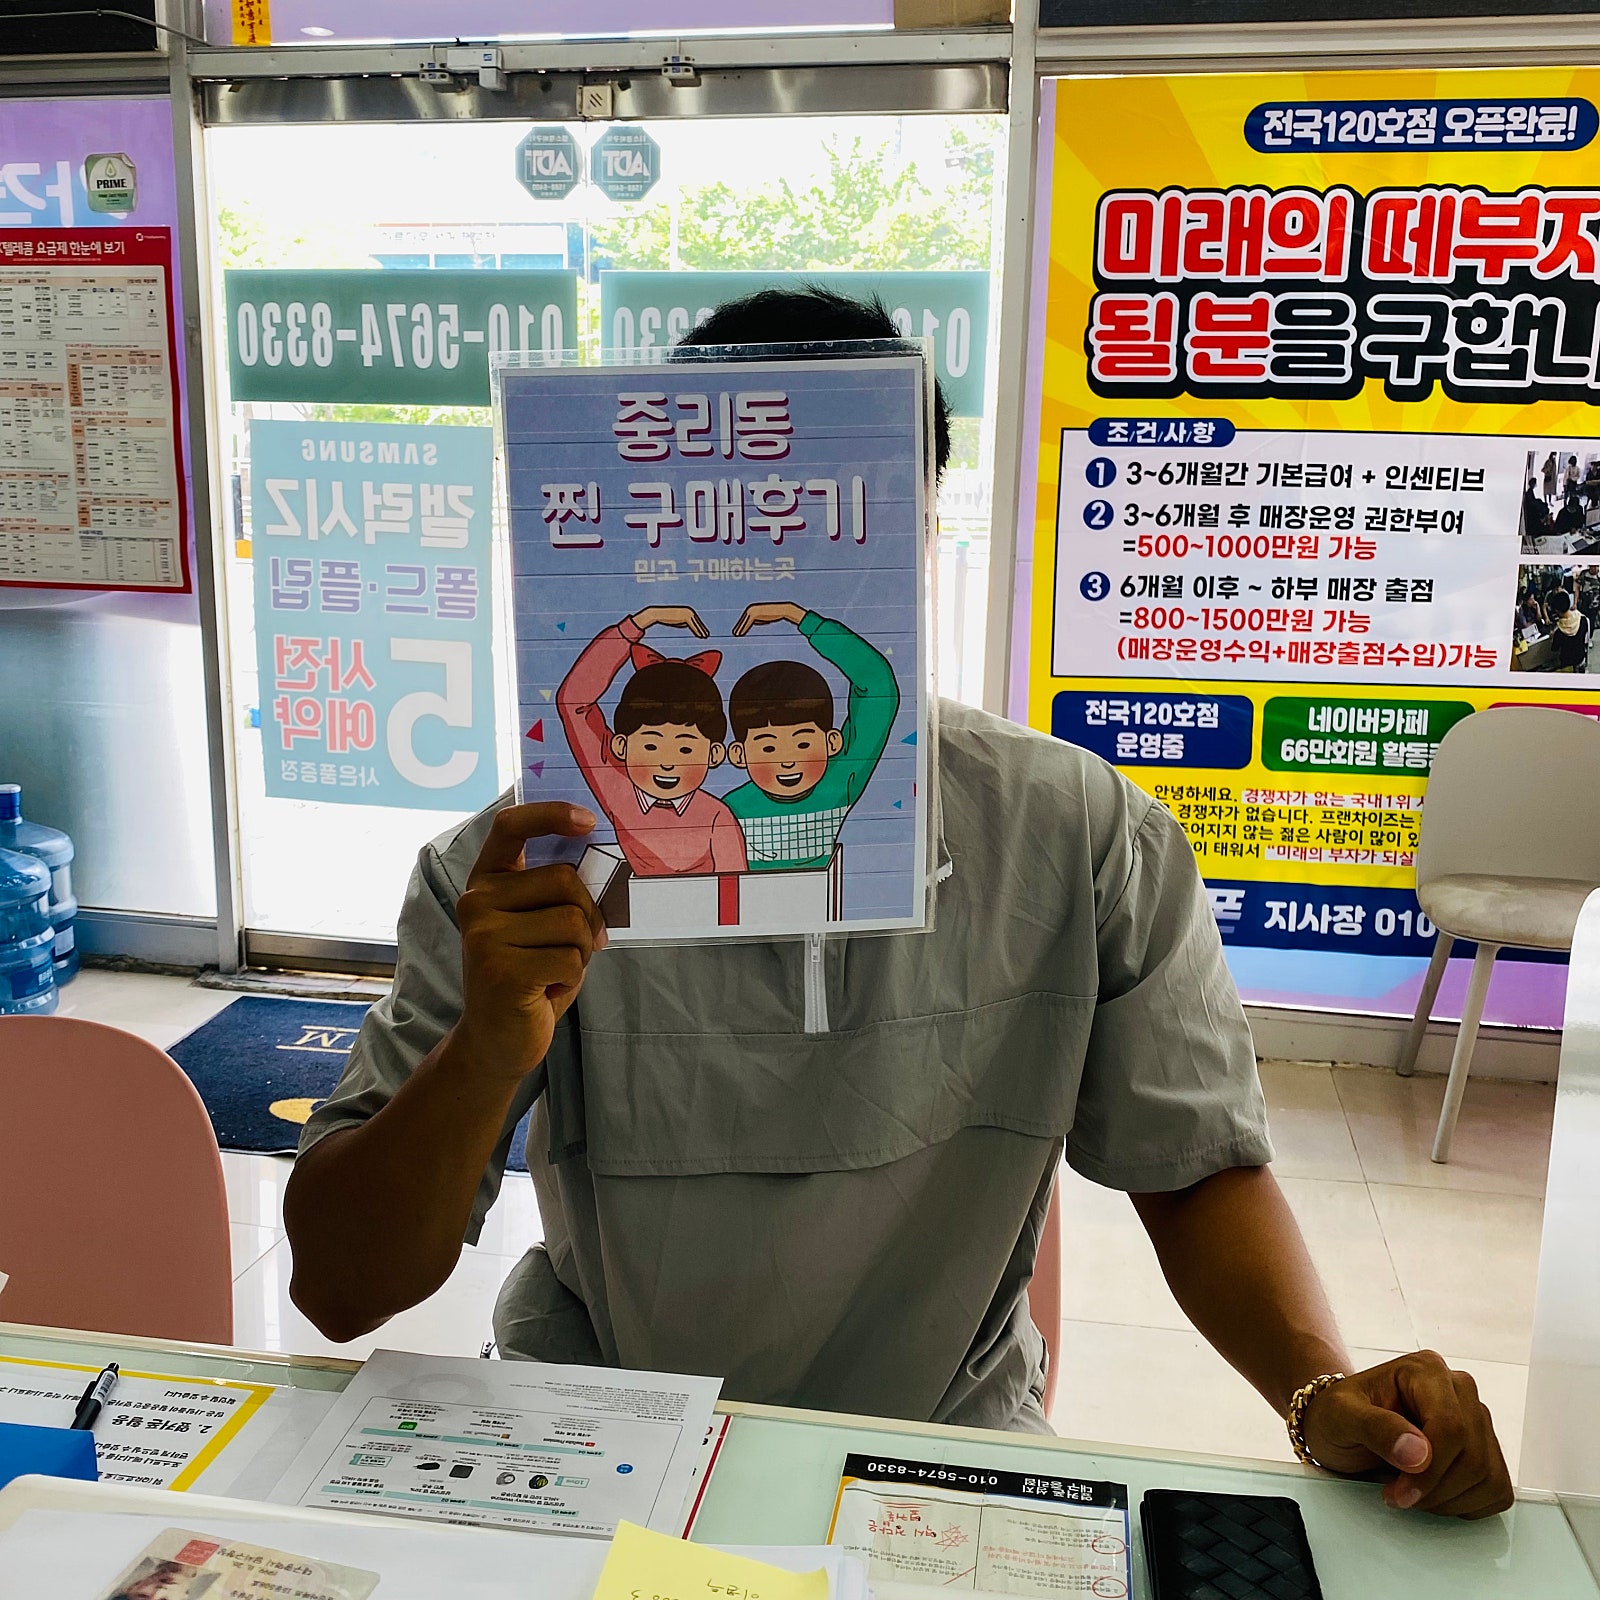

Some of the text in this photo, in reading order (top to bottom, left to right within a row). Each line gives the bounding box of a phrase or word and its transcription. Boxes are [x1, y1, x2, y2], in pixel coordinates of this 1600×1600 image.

[1262, 106, 1578, 146] 전국120호점 오픈완료!
[97, 179, 127, 189] PRIME
[36, 241, 68, 256] 요금제
[69, 241, 102, 256] 한눈에
[104, 241, 125, 255] 보기
[1097, 189, 1354, 282] 미래의
[1093, 294, 1178, 382] 될
[1186, 292, 1356, 383] 분을
[611, 390, 794, 462] 중리동
[1126, 461, 1249, 487] 3~6개월간
[1256, 462, 1353, 489] 기본급여
[1385, 466, 1485, 492] 인센티브
[540, 473, 867, 549] 찐 구매후기
[1123, 503, 1220, 528] 3~6개월
[1227, 504, 1251, 529] 후
[1259, 505, 1356, 530] 매장운영
[1364, 507, 1465, 534] 권한부여
[1123, 534, 1377, 560] =500~1000만원 가능
[634, 556, 796, 584] 믿고 구매하는곳
[1120, 575, 1184, 599] 6개월
[1193, 575, 1240, 599] 이후
[1271, 577, 1318, 601] 하부
[1327, 578, 1377, 601] 매장
[1385, 578, 1434, 603] 출점
[1120, 607, 1371, 633] =800~1500만원 가능
[1117, 637, 1498, 669] (매장운영수익+매장출점수입)가능
[1085, 699, 1219, 729] 전국120호점
[1308, 706, 1429, 736] 네이버카페
[1116, 732, 1184, 760] 운영중
[1280, 738, 1377, 767] 66만회원
[1154, 785, 1237, 802] 안녕하세요.
[1245, 788, 1307, 805] 경쟁자가
[1314, 791, 1345, 807] 없는
[1351, 793, 1411, 810] 국내1위
[1178, 804, 1415, 829] 경쟁자가 없습니다. 프랜차이즈는
[1243, 825, 1273, 841] 않는
[1280, 827, 1310, 843] 젊은
[1316, 828, 1363, 845] 사람이
[1370, 830, 1401, 847] 많이
[1214, 842, 1260, 858] 태워서
[1328, 848, 1377, 864] 부자가
[1382, 850, 1414, 867] 되실
[1264, 900, 1366, 936] 지사장
[164, 1390, 200, 1400] 있습니다
[112, 1415, 212, 1434] 2. 옆커폰 활용
[867, 1462, 998, 1486] 010-5674-8330
[1067, 1482, 1092, 1493] 대구
[1022, 1485, 1048, 1497] 성지
